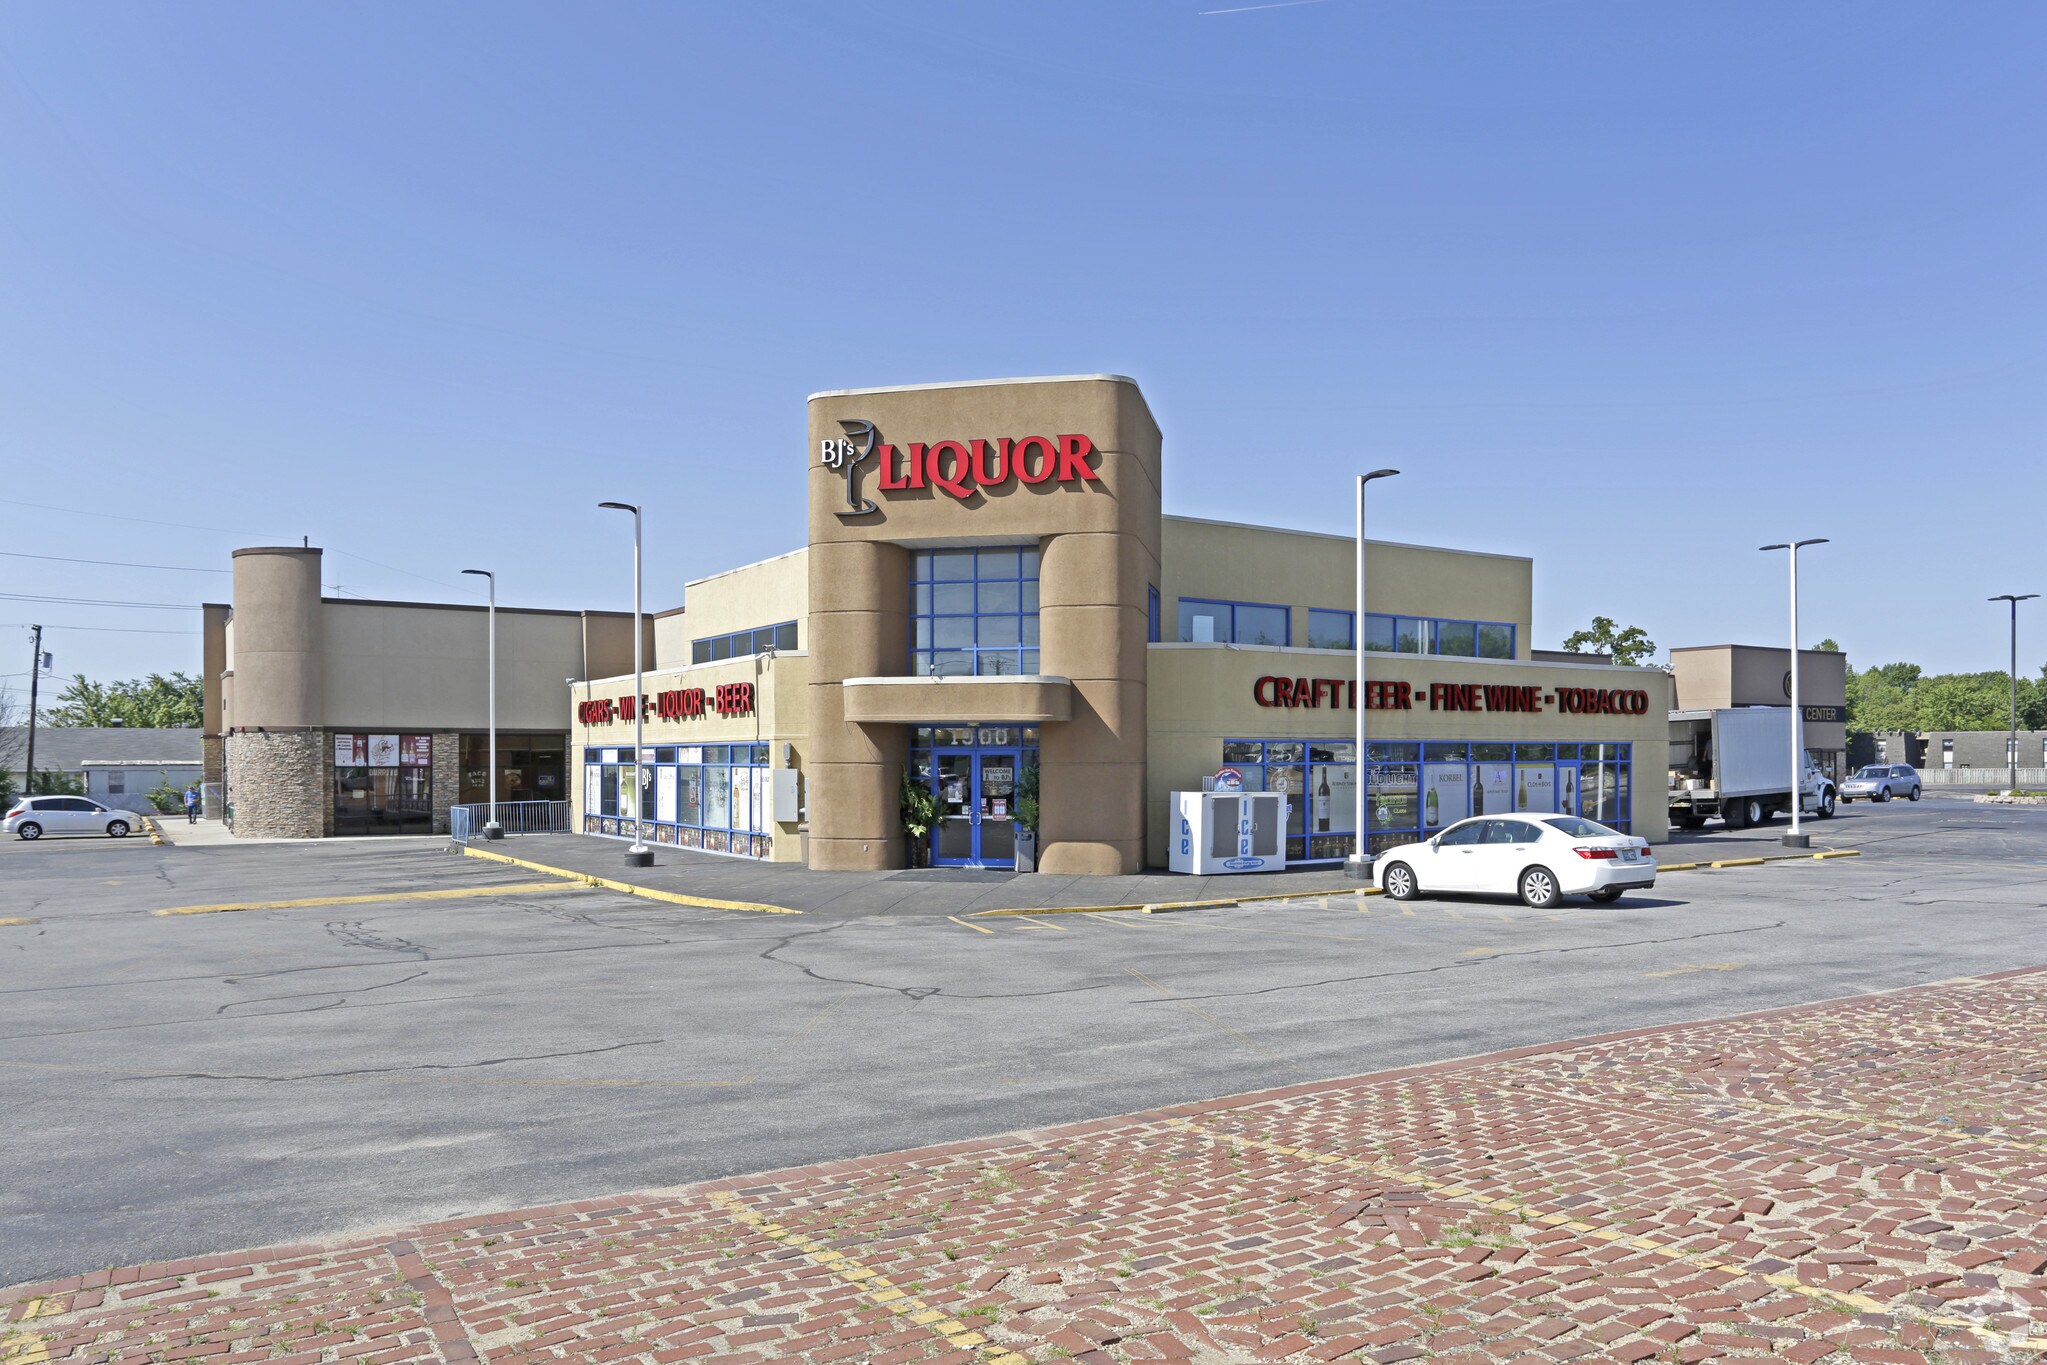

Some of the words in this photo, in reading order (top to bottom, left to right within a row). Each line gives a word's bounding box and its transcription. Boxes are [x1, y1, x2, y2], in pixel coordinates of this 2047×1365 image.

[821, 439, 855, 468] BJ's
[878, 433, 1100, 499] LIQUOR
[578, 699, 611, 723] CIGARS
[657, 687, 703, 718] LIQUOR
[716, 682, 752, 713] BEER
[1254, 676, 1345, 709] CRAFT
[1430, 683, 1482, 711] FINE
[1484, 684, 1542, 713] WINE
[1555, 687, 1649, 715] TOBACCO
[1806, 708, 1836, 720] CENTER
[951, 728, 1008, 745] 1900
[1387, 774, 1416, 785] LIGHT
[1439, 774, 1463, 782] KORBEL
